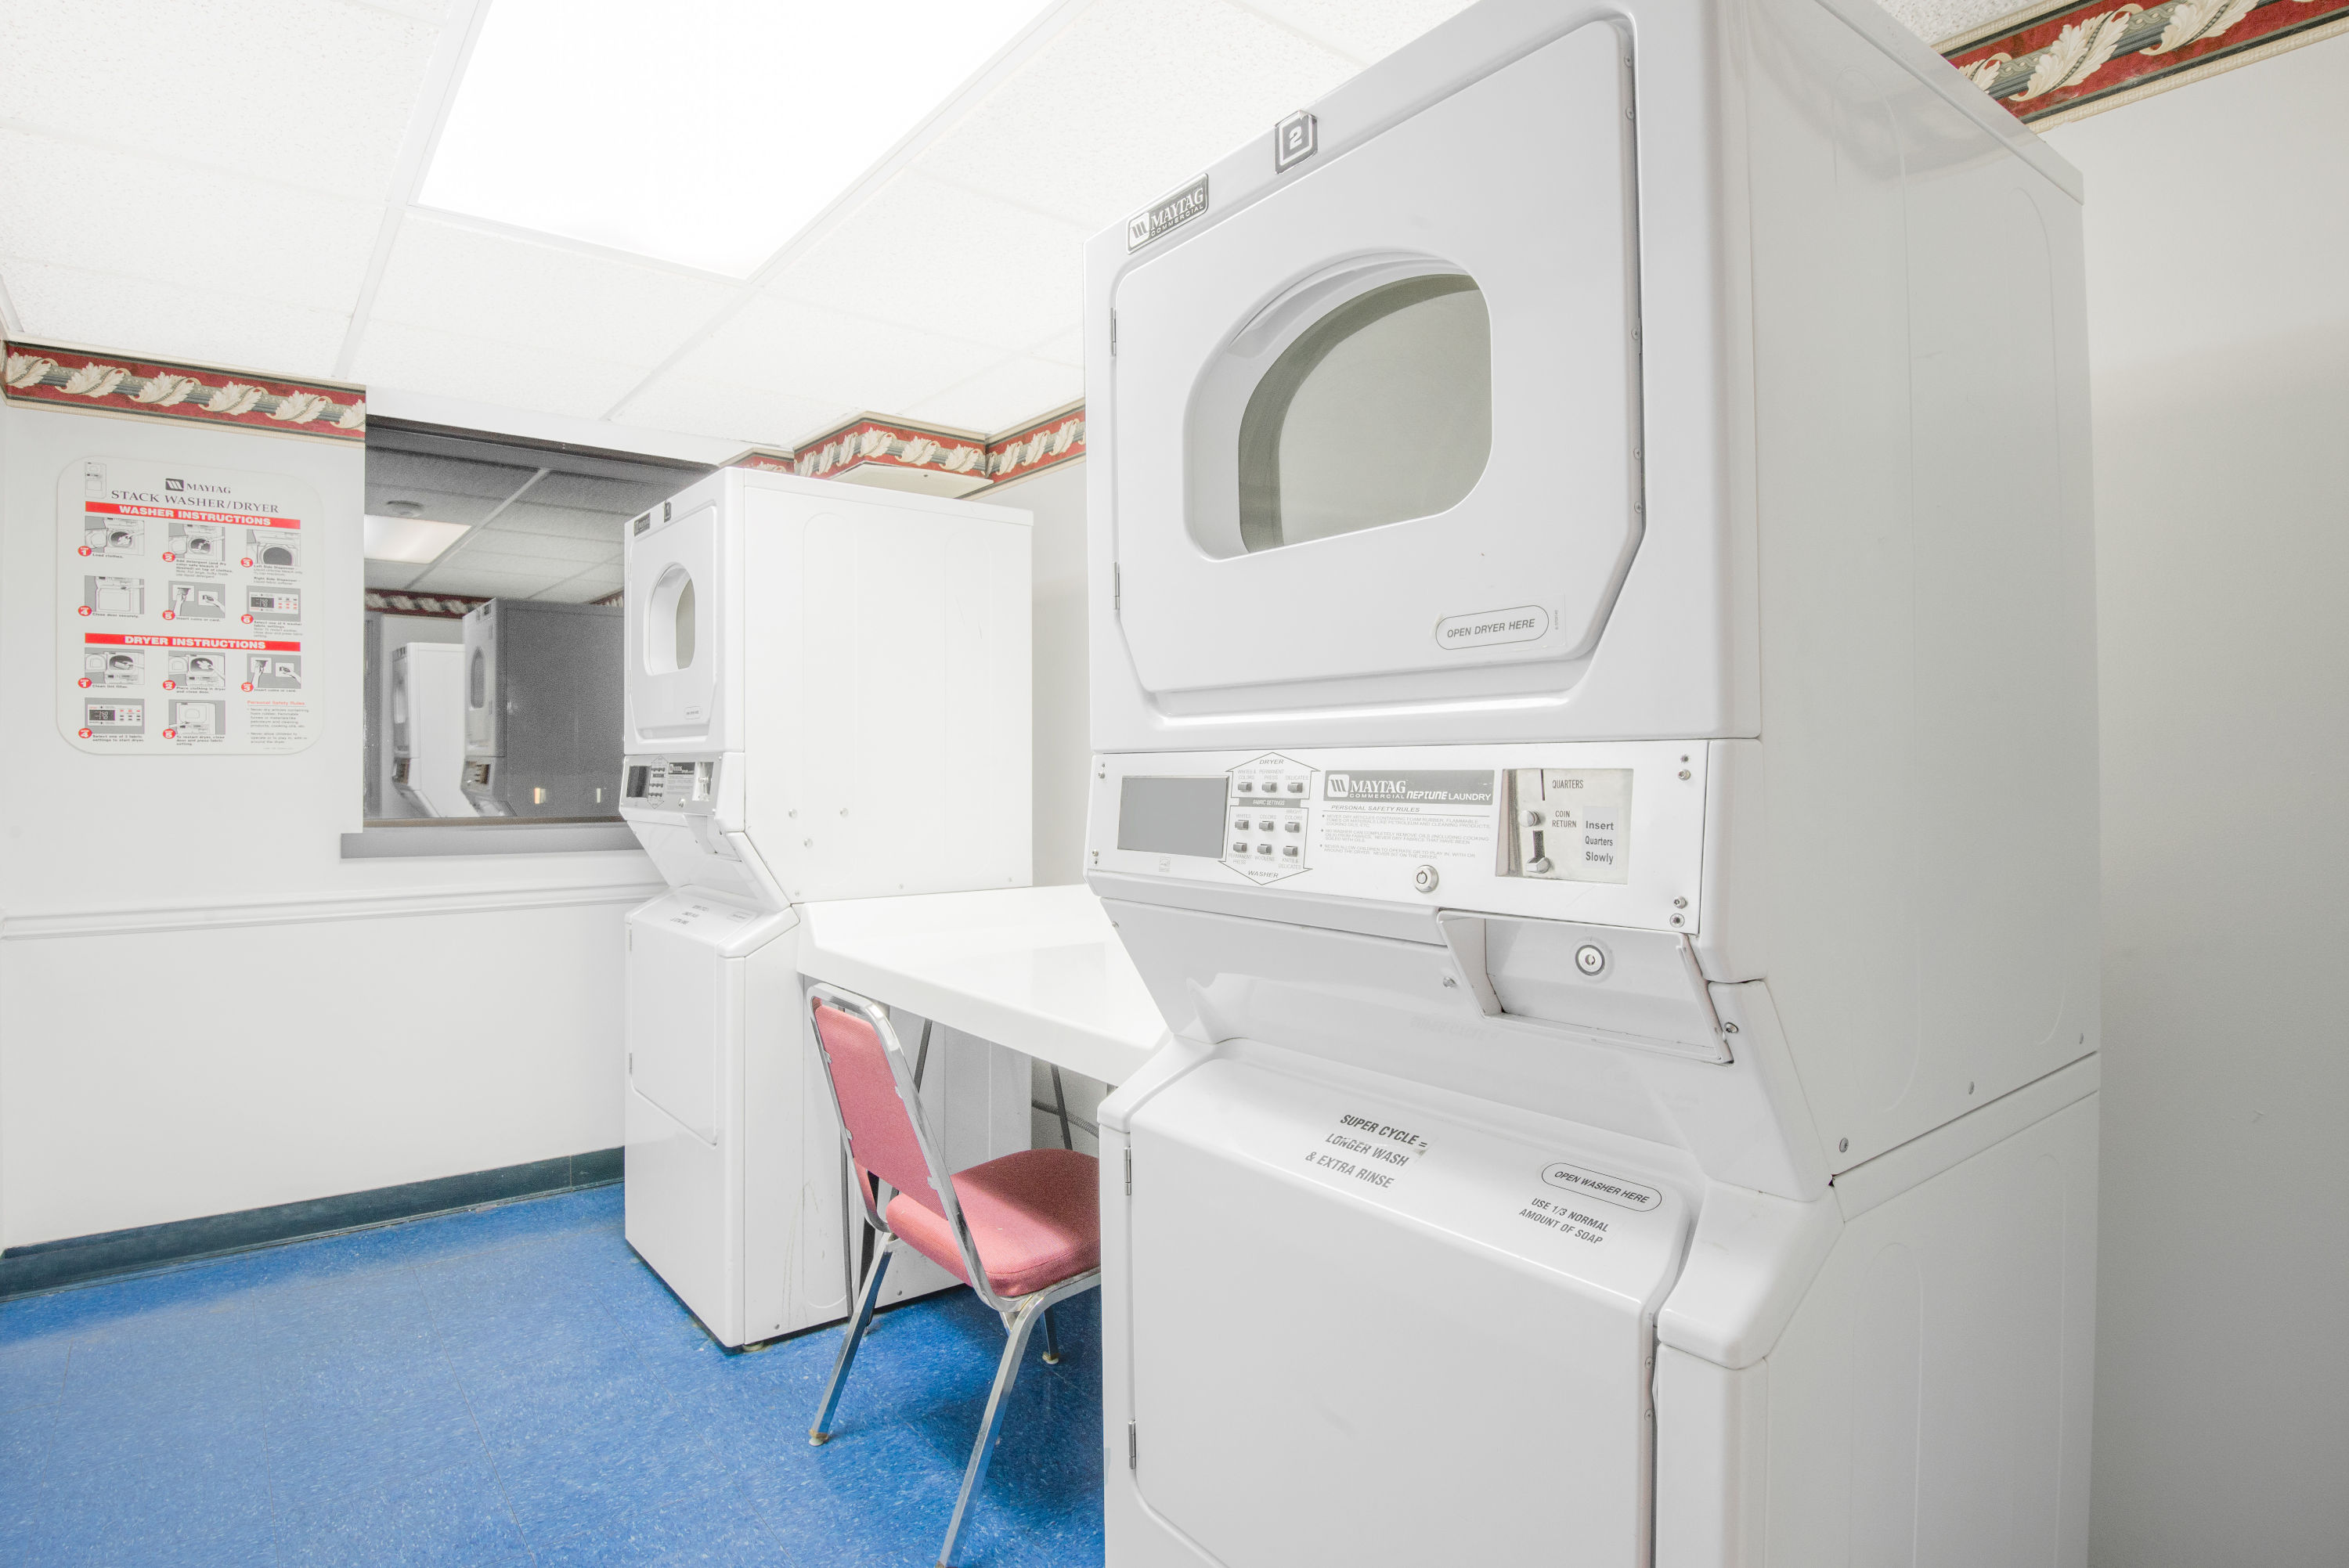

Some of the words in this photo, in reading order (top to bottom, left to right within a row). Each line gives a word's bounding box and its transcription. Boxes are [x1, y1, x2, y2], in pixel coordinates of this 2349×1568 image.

[1290, 126, 1302, 150] 2
[1151, 188, 1203, 231] MAYTAG
[1151, 204, 1203, 236] COMMERCIAL
[187, 483, 231, 494] MAYTAG
[111, 490, 160, 503] STACK
[165, 495, 279, 513] WASHER/DRYER
[119, 506, 174, 517] WASHER
[178, 510, 271, 525] INSTRUCTIONS
[1447, 627, 1472, 638] OPEN
[1474, 622, 1506, 635] DRYER
[1508, 618, 1535, 631] HERE
[124, 636, 168, 646] DRYER
[172, 637, 265, 649] INSTRUCTIONS
[1350, 780, 1406, 794] MAYTAG
[1552, 780, 1584, 789] QUARTERS
[1406, 791, 1449, 800] NEPTUNE
[1586, 820, 1615, 831] Insert
[1585, 835, 1613, 846] Quarters
[1586, 851, 1614, 865] Slowly
[1340, 1115, 1379, 1133] SUPER
[1378, 1126, 1420, 1145] CYCLE
[1325, 1134, 1372, 1155] LONGER
[1372, 1147, 1409, 1166] WASH
[1305, 1152, 1317, 1162] &
[1316, 1155, 1356, 1175] EXTRA
[1355, 1168, 1395, 1188] RINSE
[1554, 1171, 1582, 1183] OPEN
[1580, 1178, 1622, 1195] WASHER
[1620, 1190, 1650, 1203] HERE
[1532, 1198, 1551, 1210] USE
[1552, 1206, 1568, 1216] 1/3
[1568, 1211, 1610, 1232] NORMAL
[1519, 1208, 1561, 1228] AMOUNT
[1560, 1224, 1575, 1234] OF
[1575, 1229, 1604, 1245] SOAP
